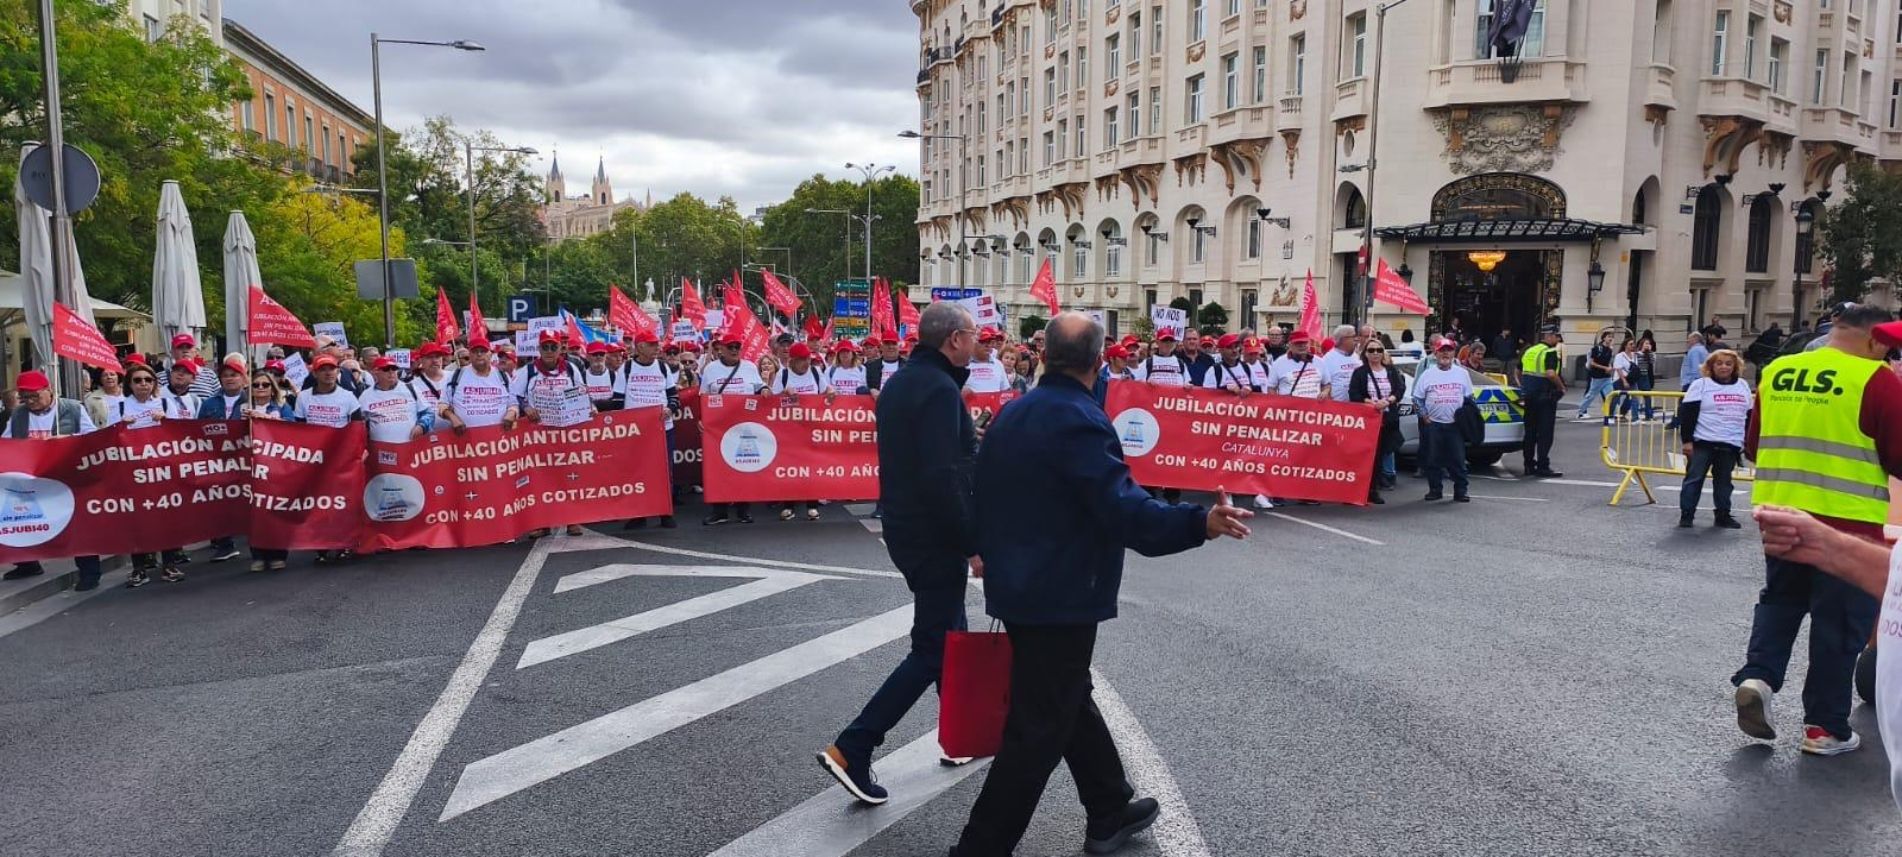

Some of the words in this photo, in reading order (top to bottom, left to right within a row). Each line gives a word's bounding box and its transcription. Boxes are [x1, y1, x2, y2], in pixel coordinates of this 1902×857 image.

[511, 299, 529, 321] P
[1772, 368, 1844, 396] GLS.
[1153, 396, 1259, 419] JUBILACIÓN
[1263, 407, 1366, 430] ANTICIPADA
[410, 435, 520, 469] JUBILACIÓN
[523, 422, 641, 447] ANTICIPADA
[811, 429, 842, 443] SIN
[1190, 420, 1221, 436] SIN
[1226, 424, 1323, 446] PENALIZAR
[76, 435, 214, 471] JUBILACIÓN
[1221, 441, 1289, 459] CATALUNYA
[133, 465, 172, 484] SIN
[457, 466, 489, 483] SIN
[496, 450, 595, 479] PENALIZAR
[775, 466, 810, 478] CON
[816, 465, 845, 478] +40
[1155, 454, 1186, 466] CON
[1191, 457, 1218, 469] +40
[1222, 459, 1266, 474] AÑOS
[1271, 464, 1356, 482] COTIZADOS
[86, 497, 135, 515] CON
[142, 492, 183, 510] +40
[191, 483, 252, 504] AÑOS
[425, 509, 459, 524] CON
[463, 506, 496, 520] +40
[503, 494, 536, 516] AÑOS
[542, 482, 646, 503] COTIZADOS
